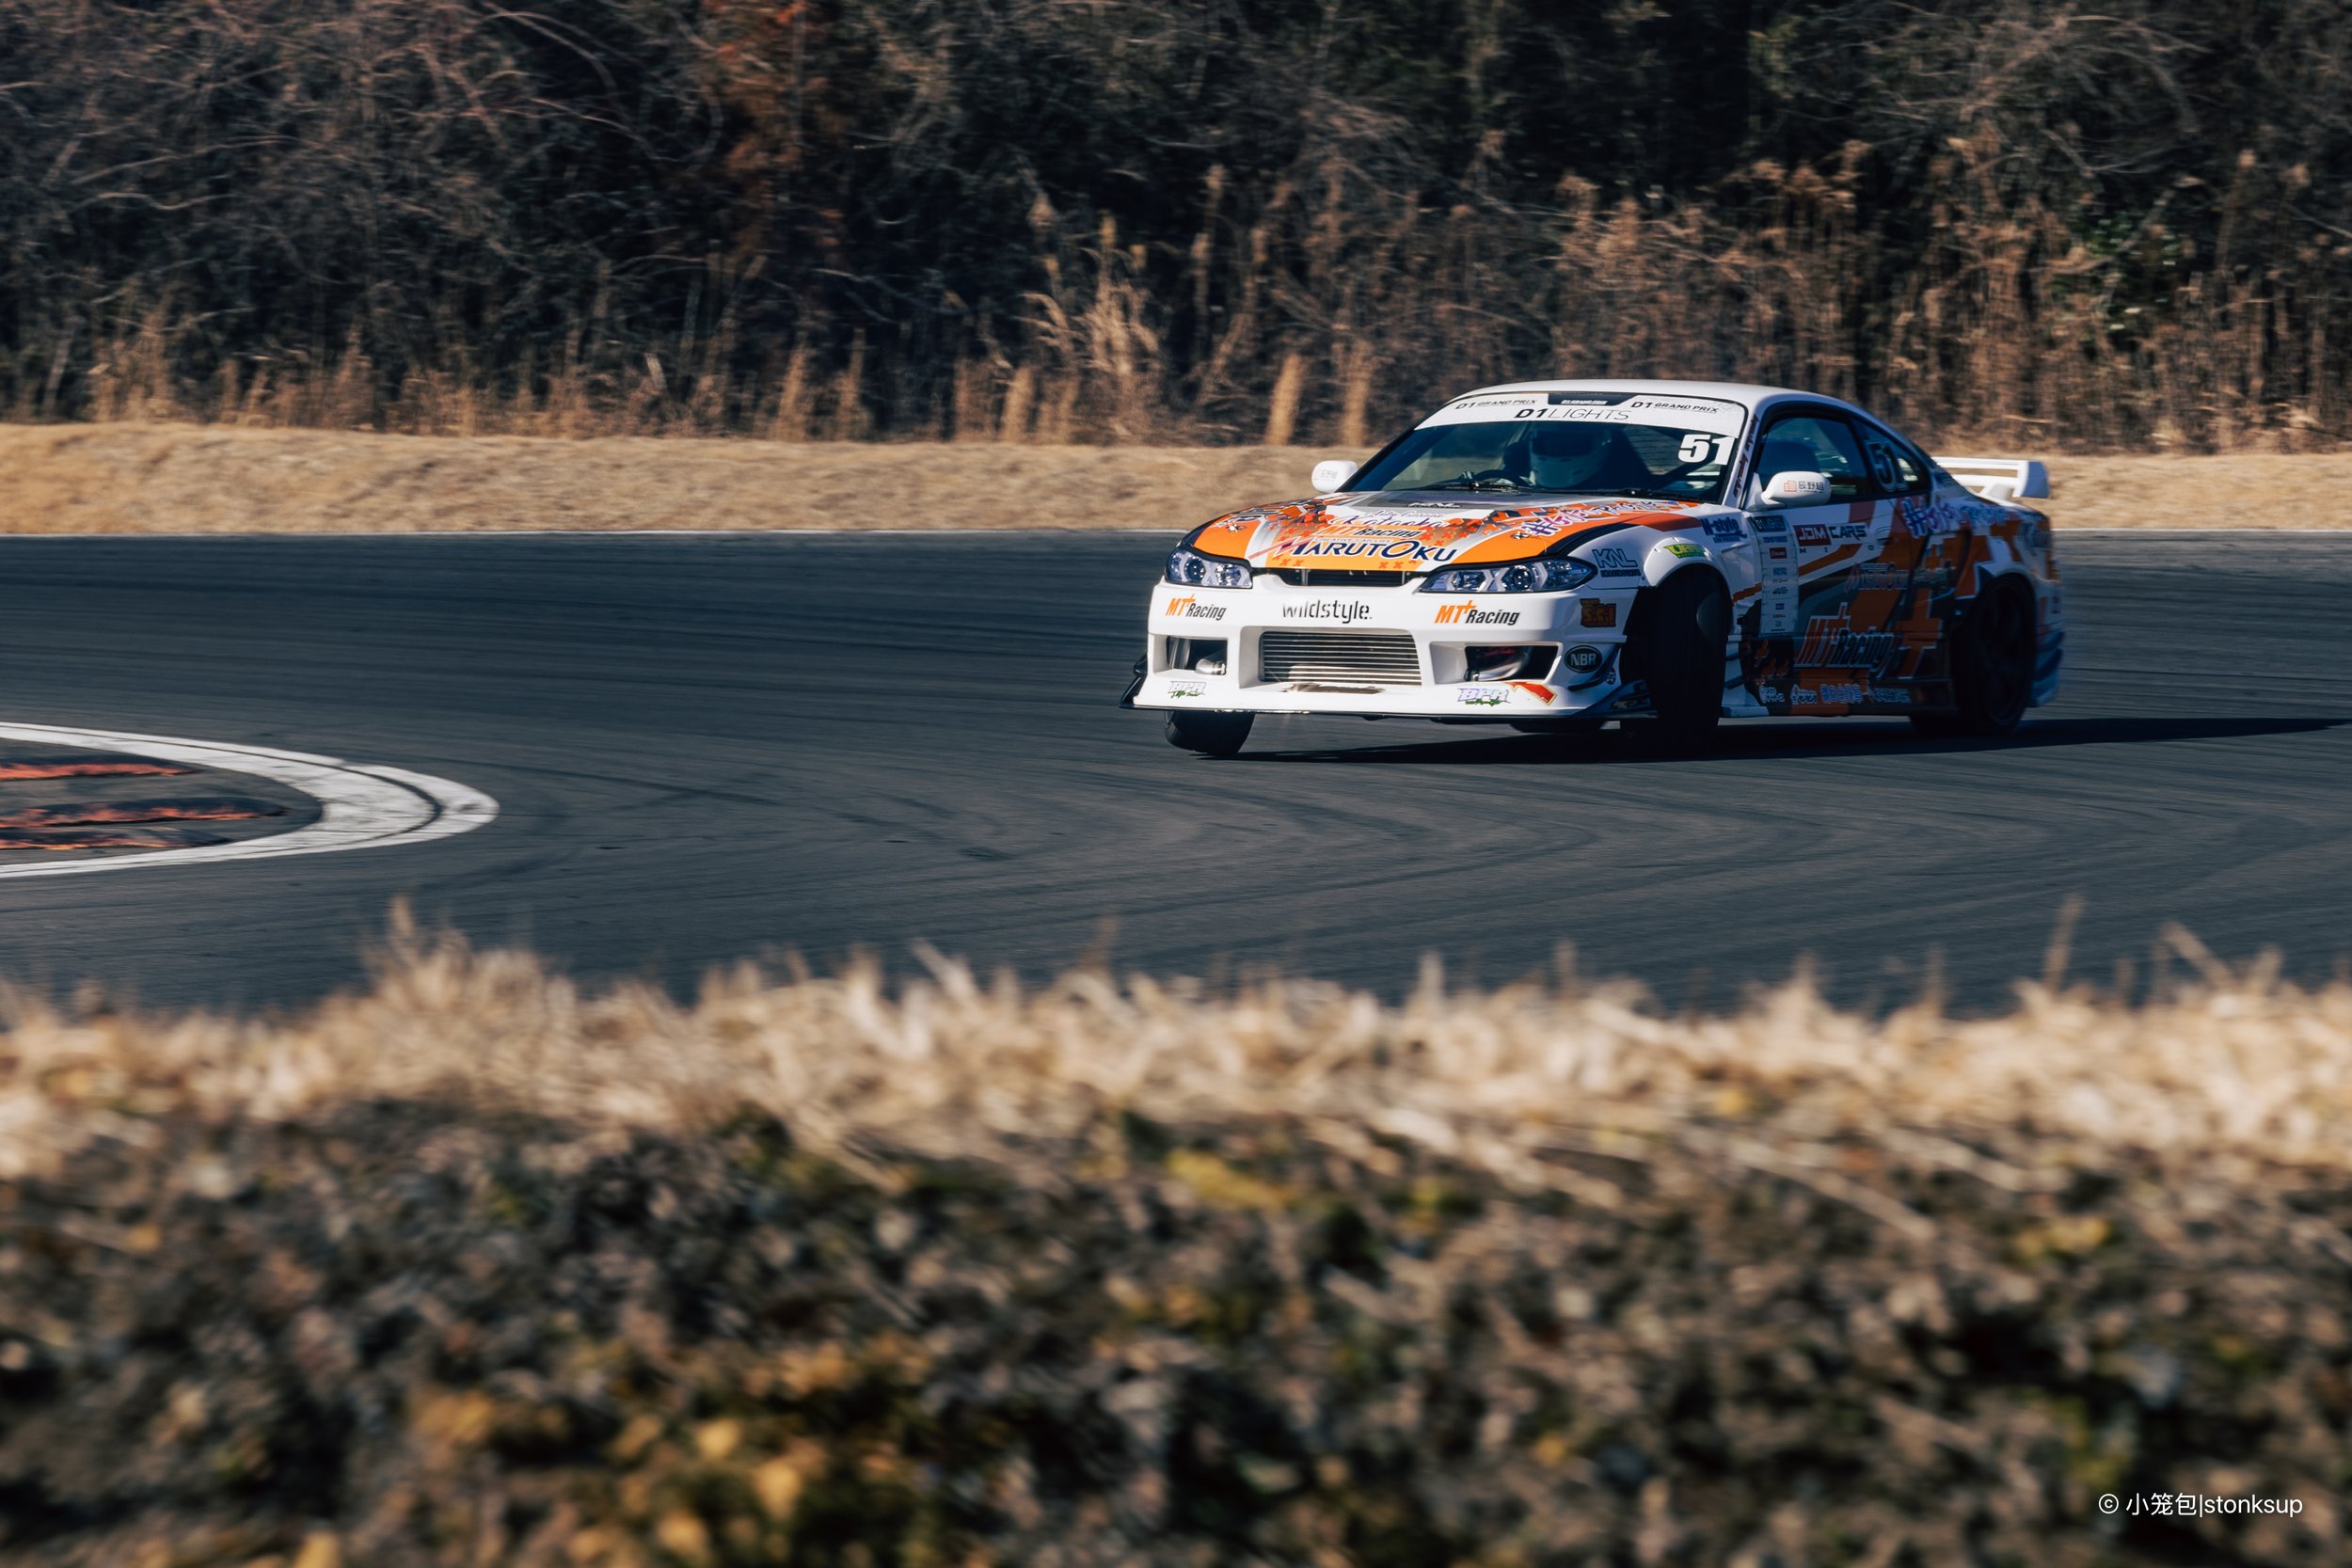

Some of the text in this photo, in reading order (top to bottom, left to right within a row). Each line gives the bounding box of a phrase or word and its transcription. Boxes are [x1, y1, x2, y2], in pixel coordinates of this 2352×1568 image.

[1677, 434, 1736, 466] 51
[1352, 528, 1422, 538] Racing
[1798, 525, 1867, 541] JDM CARS
[1592, 548, 1639, 568] KNL
[1185, 602, 1228, 621] Racing
[1465, 609, 1521, 626] Racing
